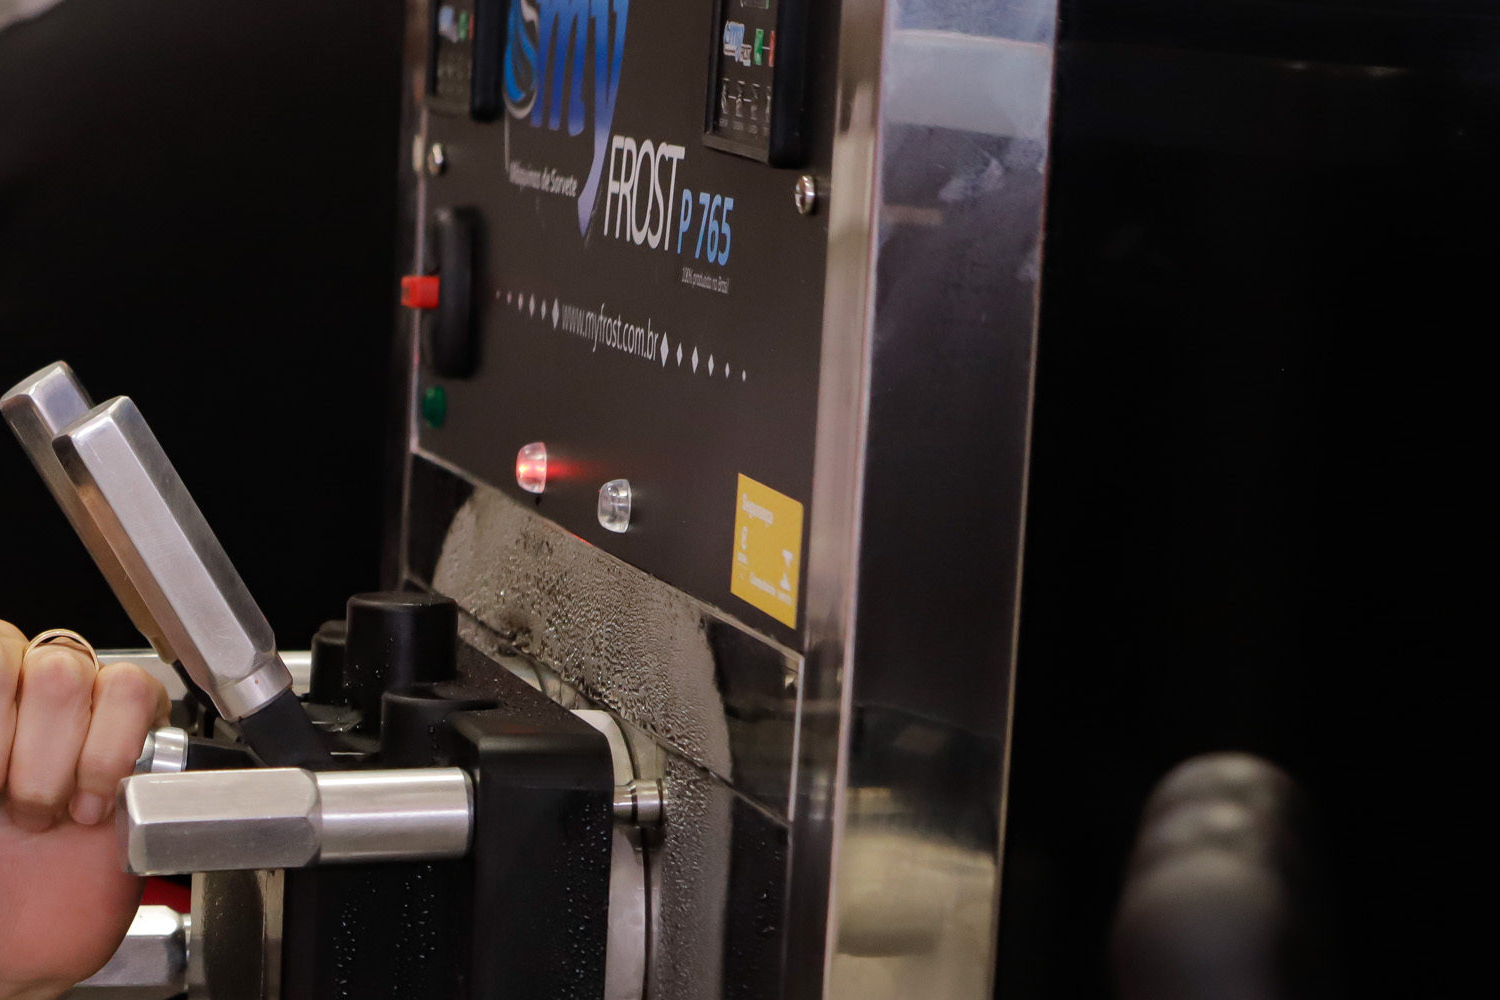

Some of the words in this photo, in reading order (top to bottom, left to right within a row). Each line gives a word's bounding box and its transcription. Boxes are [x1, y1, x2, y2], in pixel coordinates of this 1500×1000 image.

[550, 168, 578, 197] Sorvete
[604, 135, 685, 251] FROST
[677, 188, 693, 254] P
[695, 192, 734, 266] 765
[562, 302, 659, 360] www.myfrost.com.br
